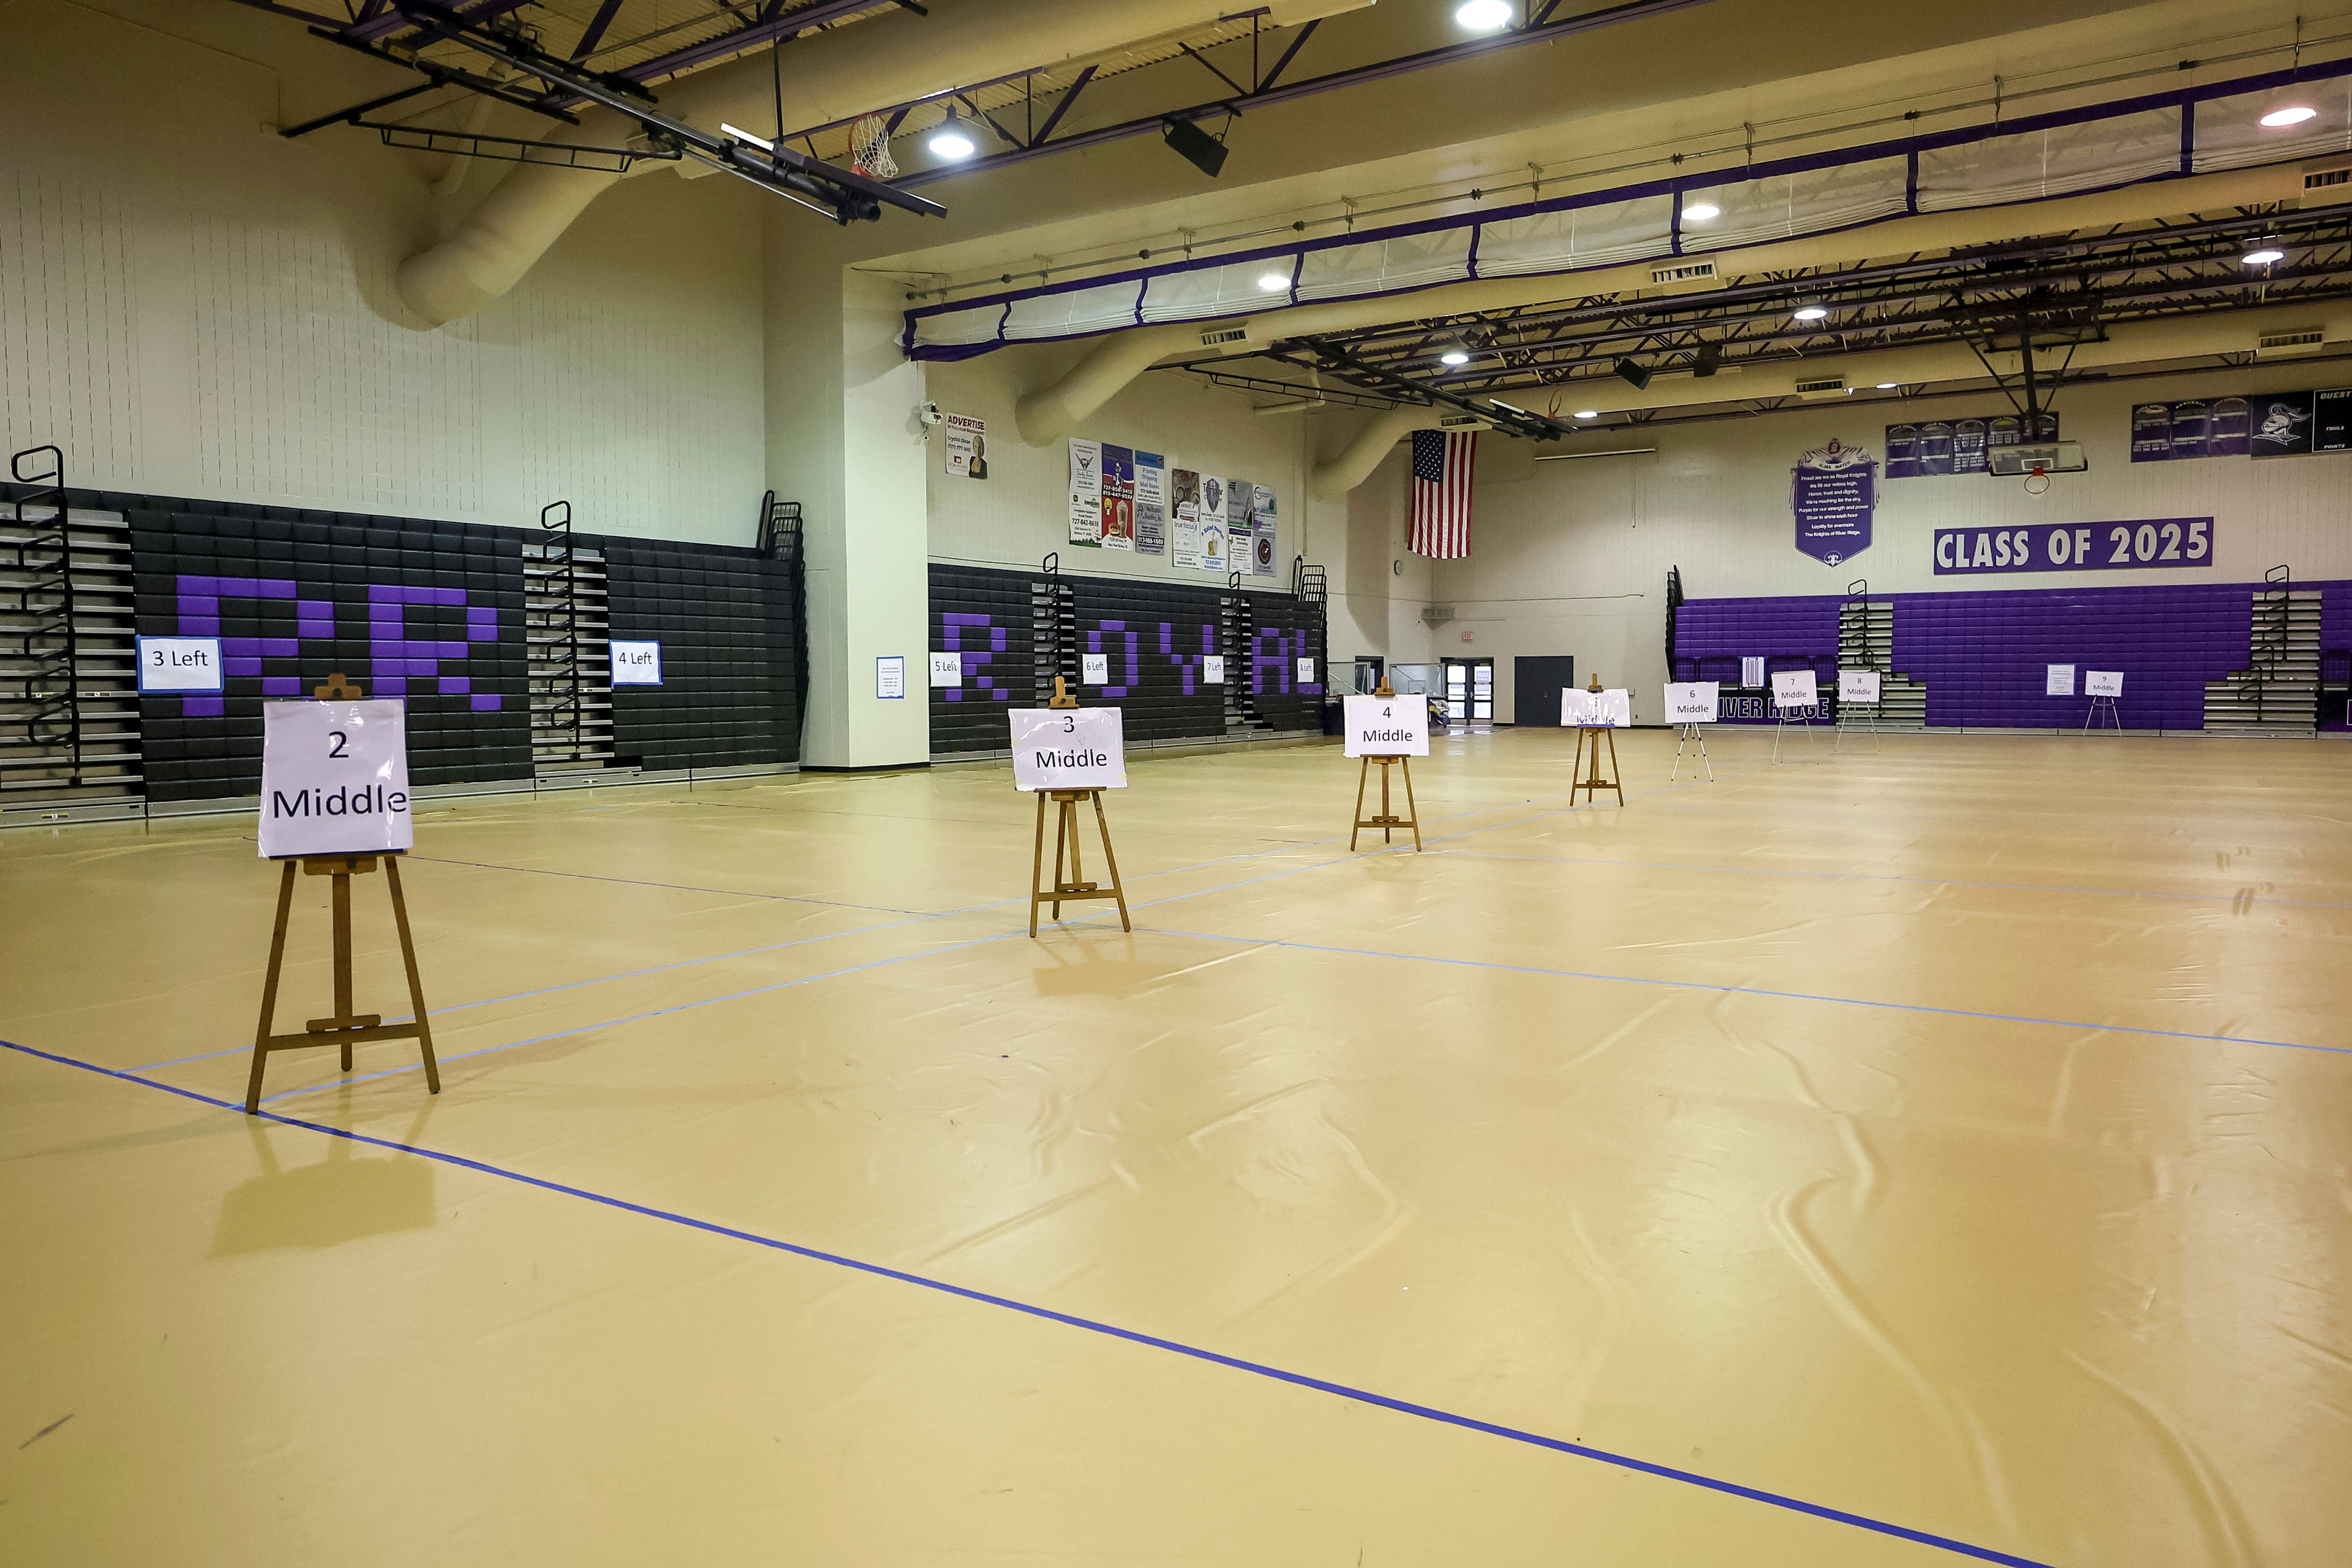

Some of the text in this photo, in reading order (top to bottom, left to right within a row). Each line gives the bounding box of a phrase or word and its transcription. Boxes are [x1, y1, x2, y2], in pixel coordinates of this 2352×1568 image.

[2320, 391, 2352, 400] GUEST
[948, 415, 985, 430] ADVERTISE
[1834, 460, 1852, 469] MATER
[1143, 467, 1157, 477] Printing
[1142, 474, 1157, 483] Shipping
[1183, 522, 1194, 530] focus
[1936, 522, 2208, 568] CLASS OF 2025
[153, 650, 208, 666] 3 Left
[619, 652, 652, 665] 4 Left
[935, 661, 957, 671] 5 Left
[1087, 662, 1104, 671] 6 Left
[1212, 662, 1221, 671] Left
[1781, 690, 1807, 699] Middle
[1382, 707, 1392, 718] 4
[1677, 704, 1709, 714] Middle
[1717, 697, 1763, 718] IVER
[1063, 715, 1075, 733] 3
[1577, 715, 1615, 725] Mdle
[1363, 729, 1413, 742] Middle
[328, 731, 349, 759] 2
[1036, 749, 1107, 769] Middle
[273, 784, 407, 819] Middle
